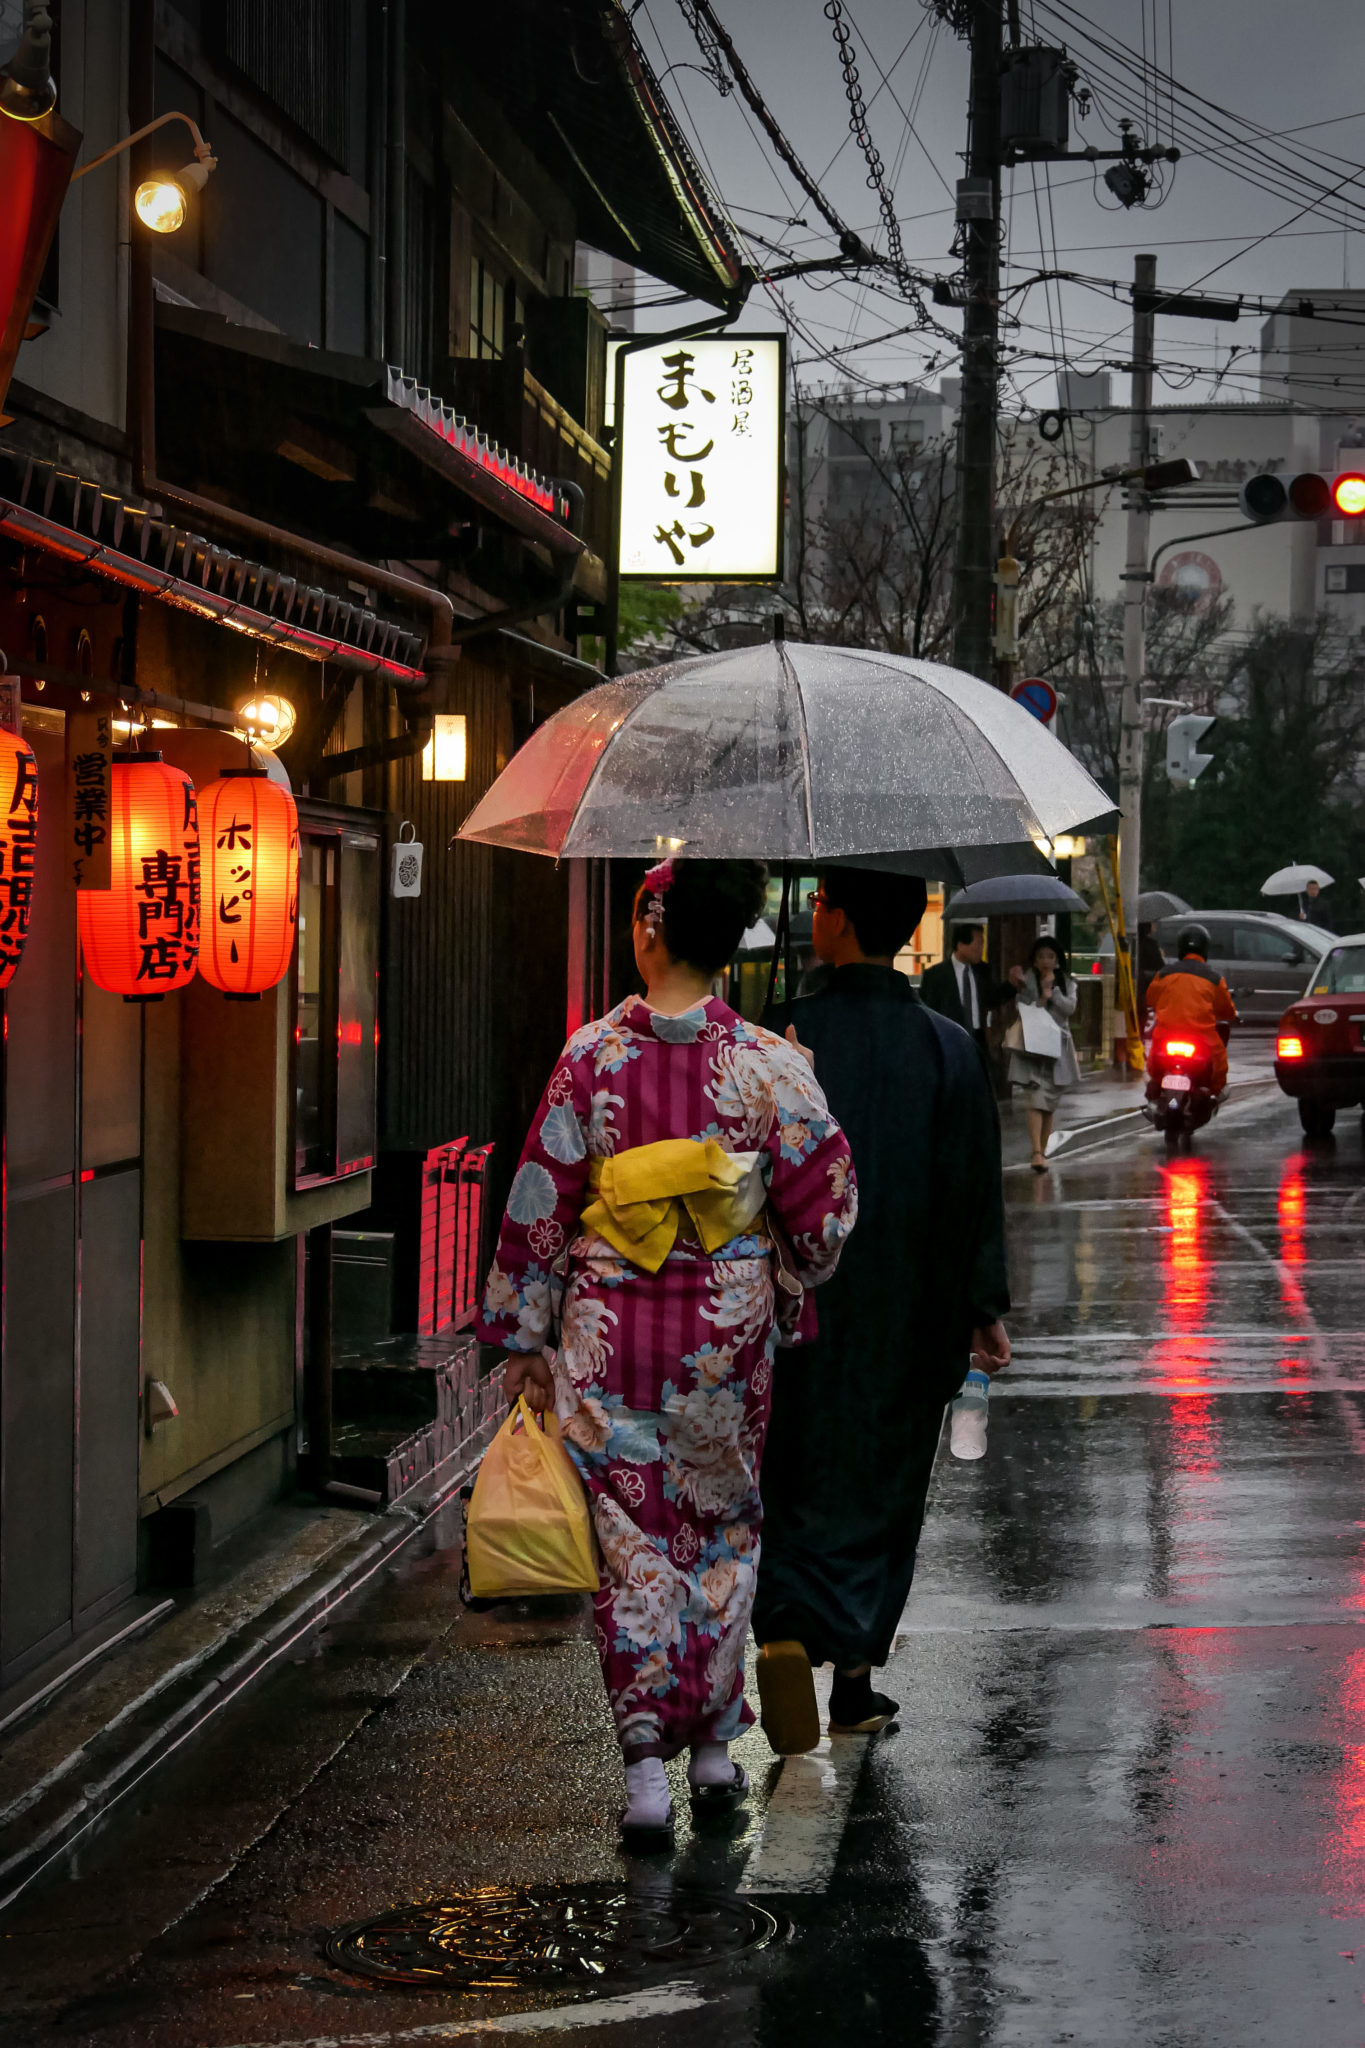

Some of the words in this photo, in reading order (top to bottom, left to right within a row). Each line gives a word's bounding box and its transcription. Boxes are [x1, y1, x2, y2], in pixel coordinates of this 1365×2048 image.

[731, 349, 754, 437] 居酒屋
[653, 349, 717, 565] まもりや
[72, 752, 108, 857] 営業中
[72, 859, 84, 887] です
[135, 849, 189, 981] 専門店
[217, 814, 253, 963] ホッピー
